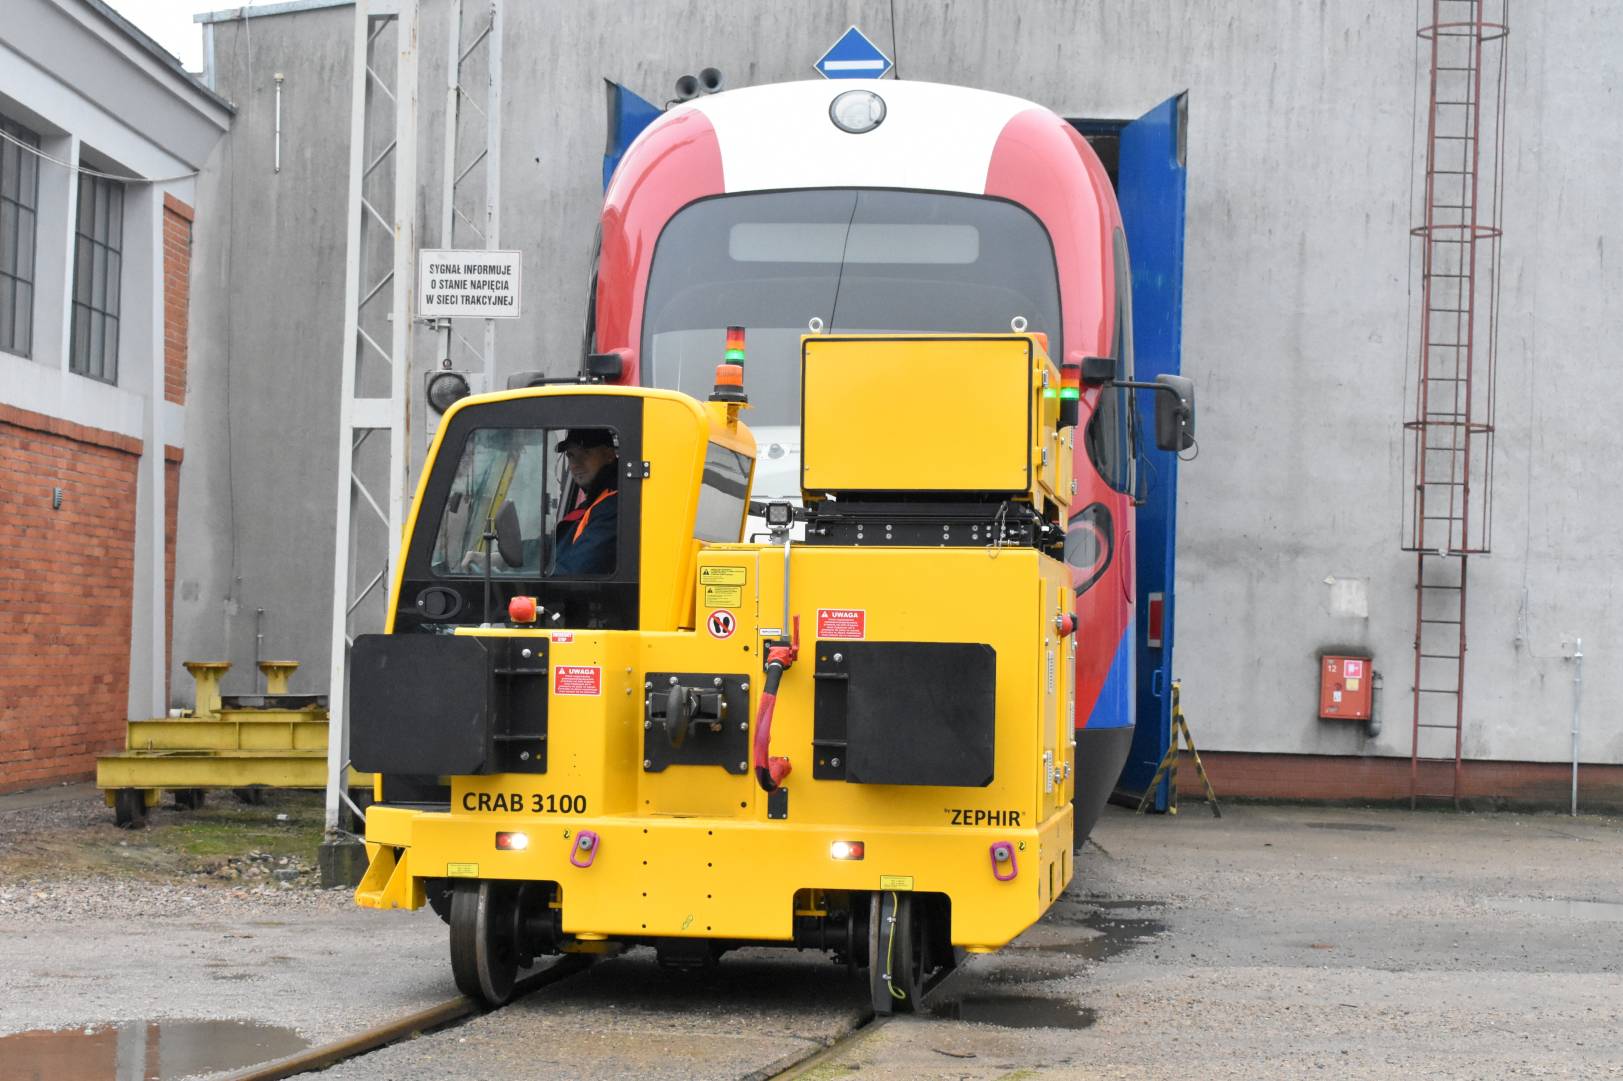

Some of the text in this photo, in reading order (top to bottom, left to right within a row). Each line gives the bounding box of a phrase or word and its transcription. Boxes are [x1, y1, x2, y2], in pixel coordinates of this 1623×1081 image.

[429, 263, 512, 276] SYGNAŁ INFORMUJE
[430, 279, 509, 293] O STANIE NAPIĘCIA
[425, 294, 514, 306] W SIECI TRAKCYJNEJ
[1327, 664, 1337, 673] 12
[462, 792, 587, 814] CRAB 3100
[951, 809, 1021, 827] ZEPHIR
